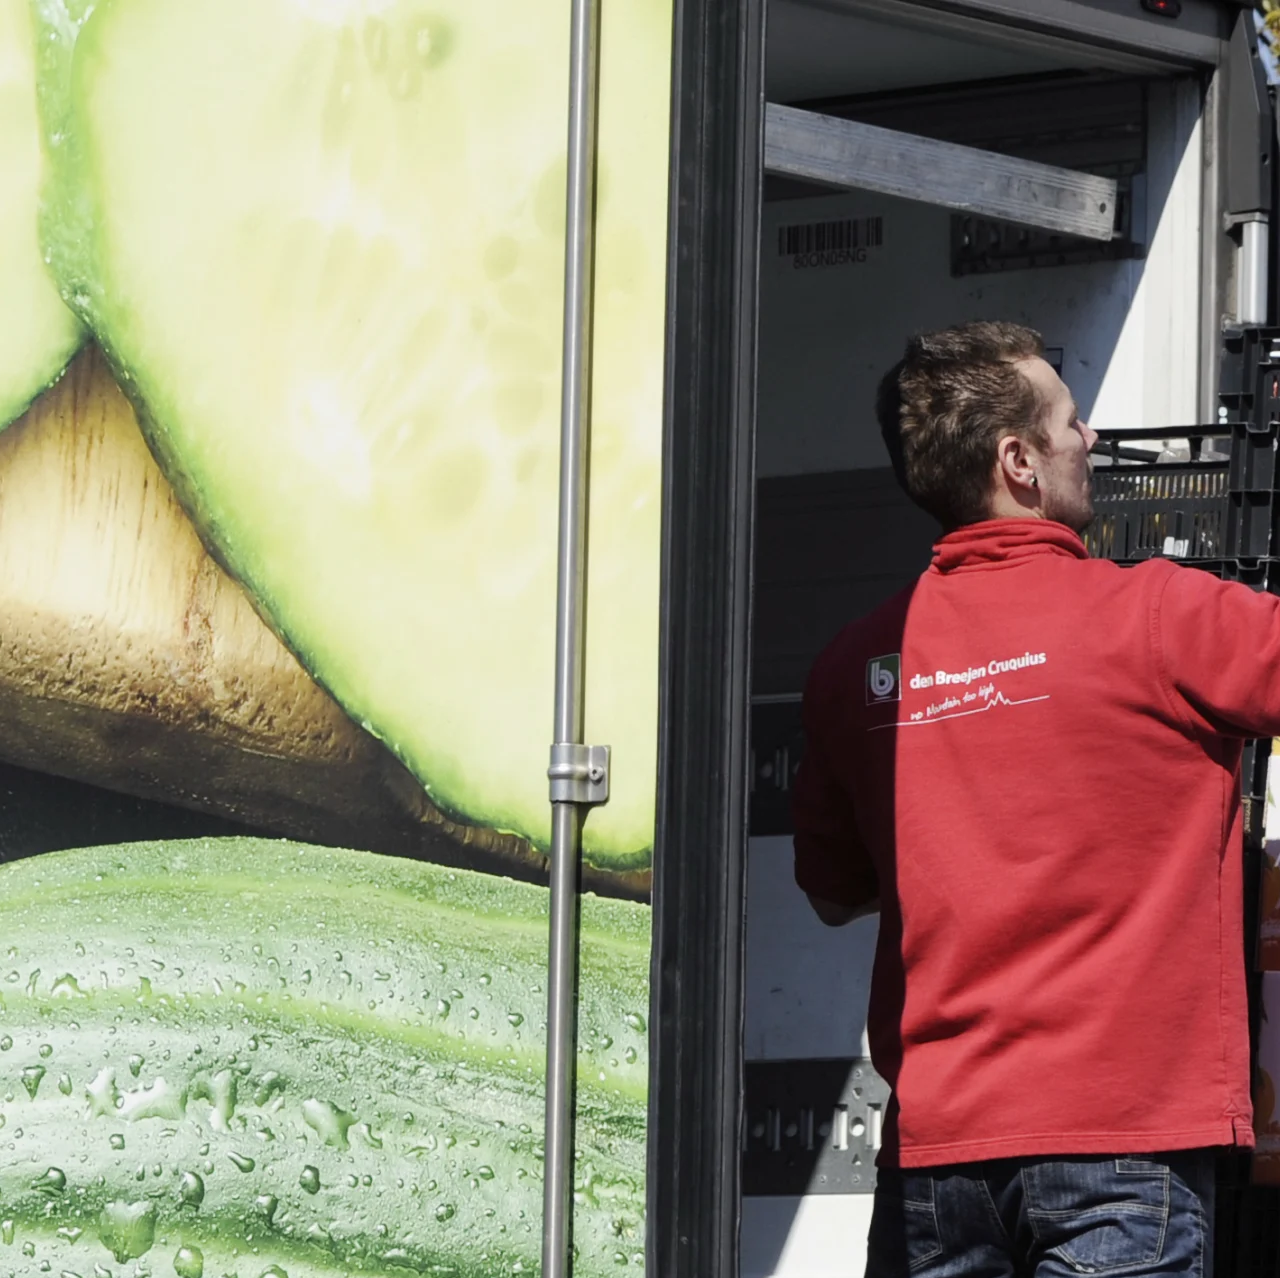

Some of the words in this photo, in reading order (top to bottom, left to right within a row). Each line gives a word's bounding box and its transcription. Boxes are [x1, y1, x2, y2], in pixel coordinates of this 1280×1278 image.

[909, 674, 934, 689] den
[935, 666, 987, 686] Breejen
[988, 652, 1047, 676] Cruquius
